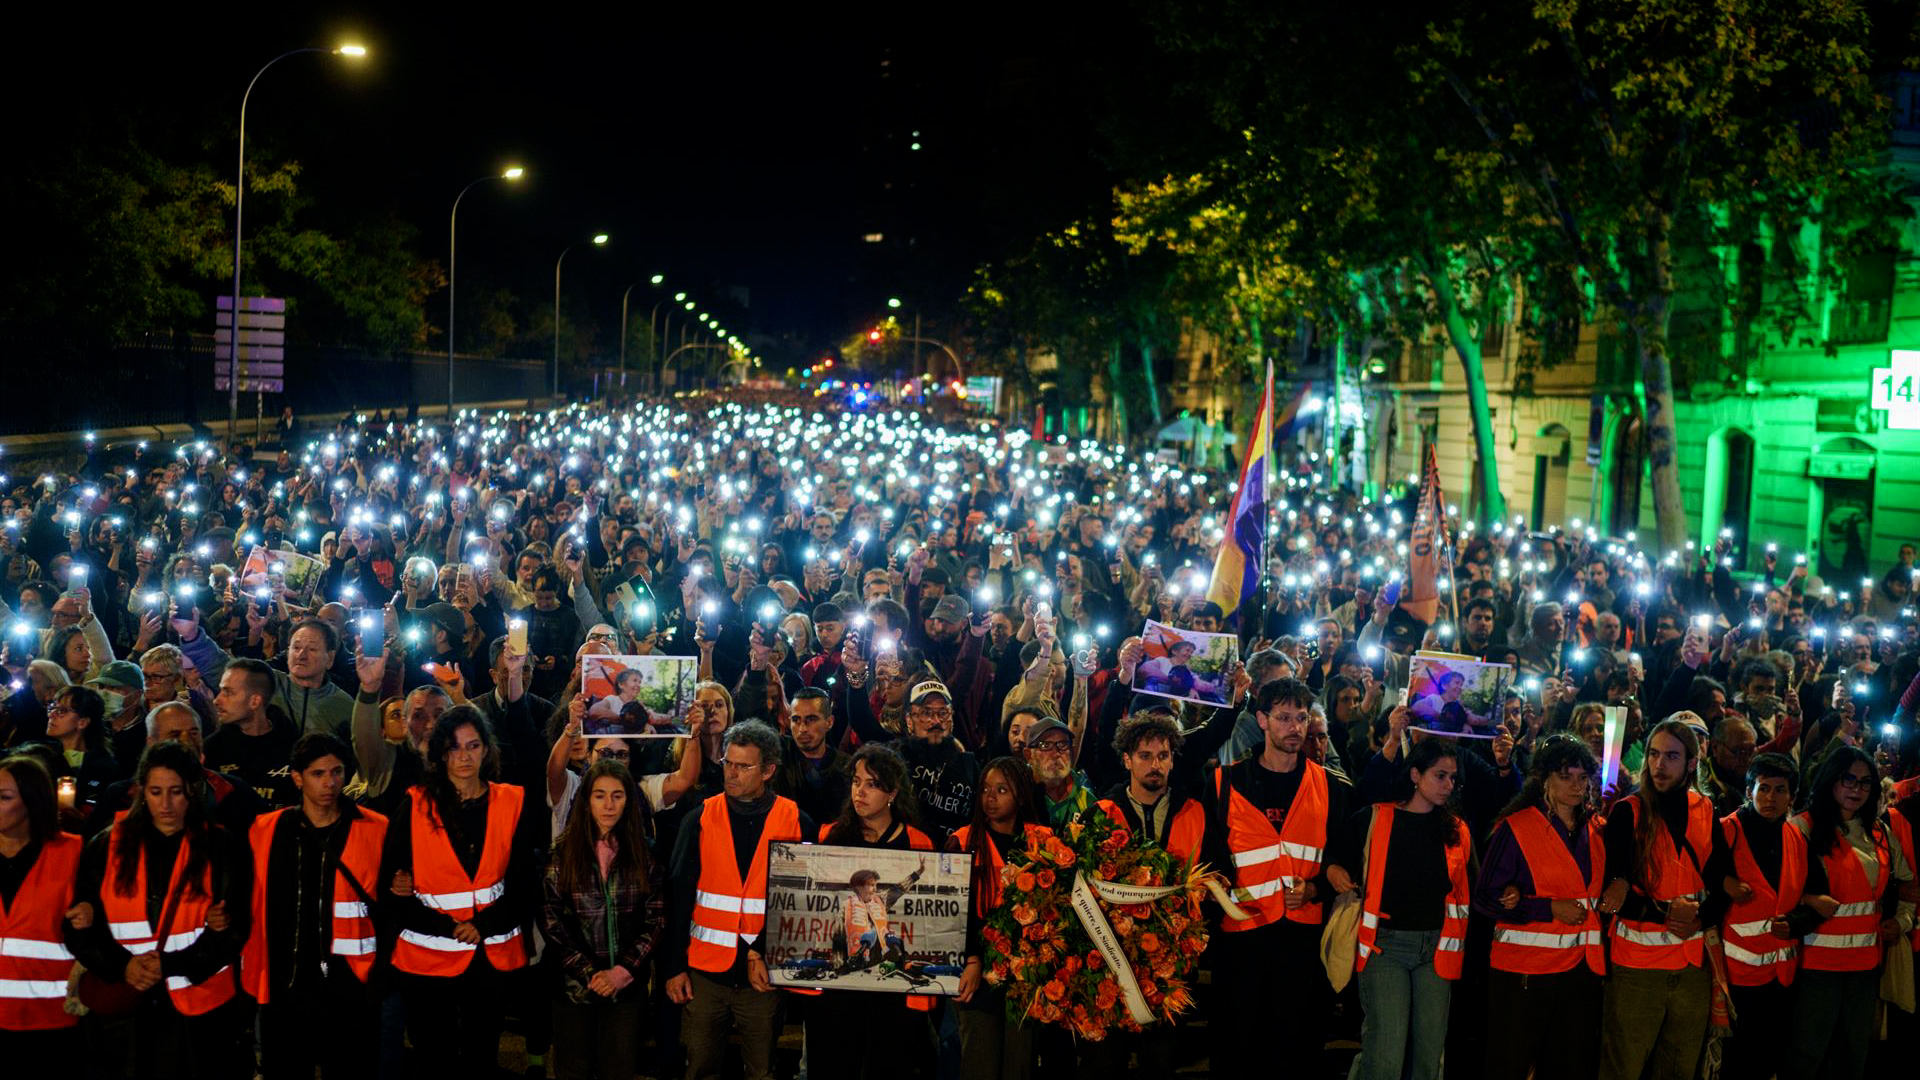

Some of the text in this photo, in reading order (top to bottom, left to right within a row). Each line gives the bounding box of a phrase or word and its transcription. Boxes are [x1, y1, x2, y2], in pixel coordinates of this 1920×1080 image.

[1074, 886, 1082, 899] Te
[806, 894, 840, 913] VIDA
[903, 898, 960, 917] BARRIO
